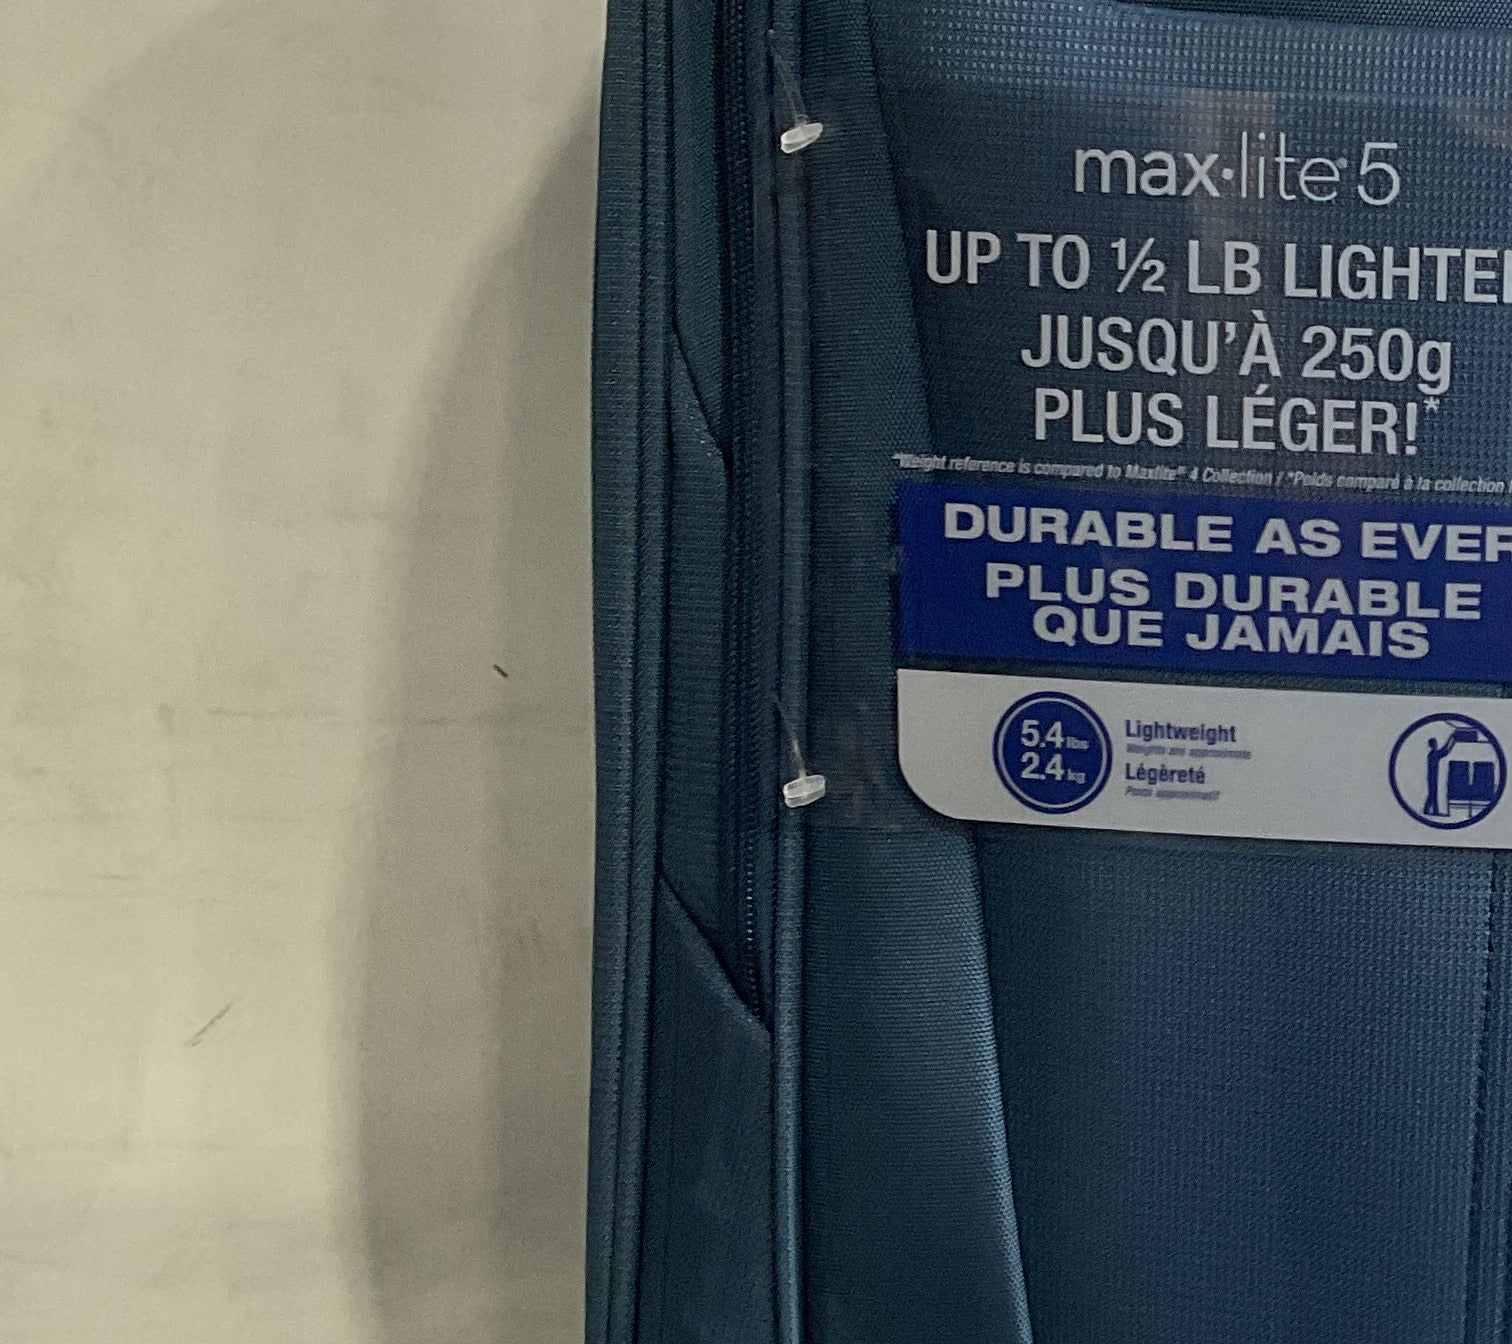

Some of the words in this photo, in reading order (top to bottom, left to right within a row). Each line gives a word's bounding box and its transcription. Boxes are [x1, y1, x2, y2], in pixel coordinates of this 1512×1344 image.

[1357, 142, 1401, 207] 5
[925, 229, 1001, 286] UP
[1017, 232, 1090, 290] TO
[1186, 240, 1261, 297] LB
[1301, 326, 1453, 396] 250g
[1034, 387, 1184, 448] PLUS
[949, 456, 1016, 475] reference
[1018, 458, 1031, 475] is
[1034, 462, 1104, 479] compared
[1108, 463, 1122, 479] to
[1189, 466, 1199, 482] 4
[1202, 467, 1274, 486] Collection
[1416, 475, 1431, 492] la
[1434, 475, 1505, 494] collection
[943, 501, 1234, 554] DURABLE
[1255, 518, 1342, 559] AS
[985, 561, 1151, 607] PLUS
[1174, 573, 1483, 621] DURABLE
[1032, 603, 1165, 649] QUE
[1185, 611, 1430, 660] JAMAIS
[1020, 719, 1066, 750] 5.4
[1124, 719, 1237, 746] Lightweight
[1020, 751, 1066, 782] 2.4
[1124, 761, 1206, 786] Légèreté
